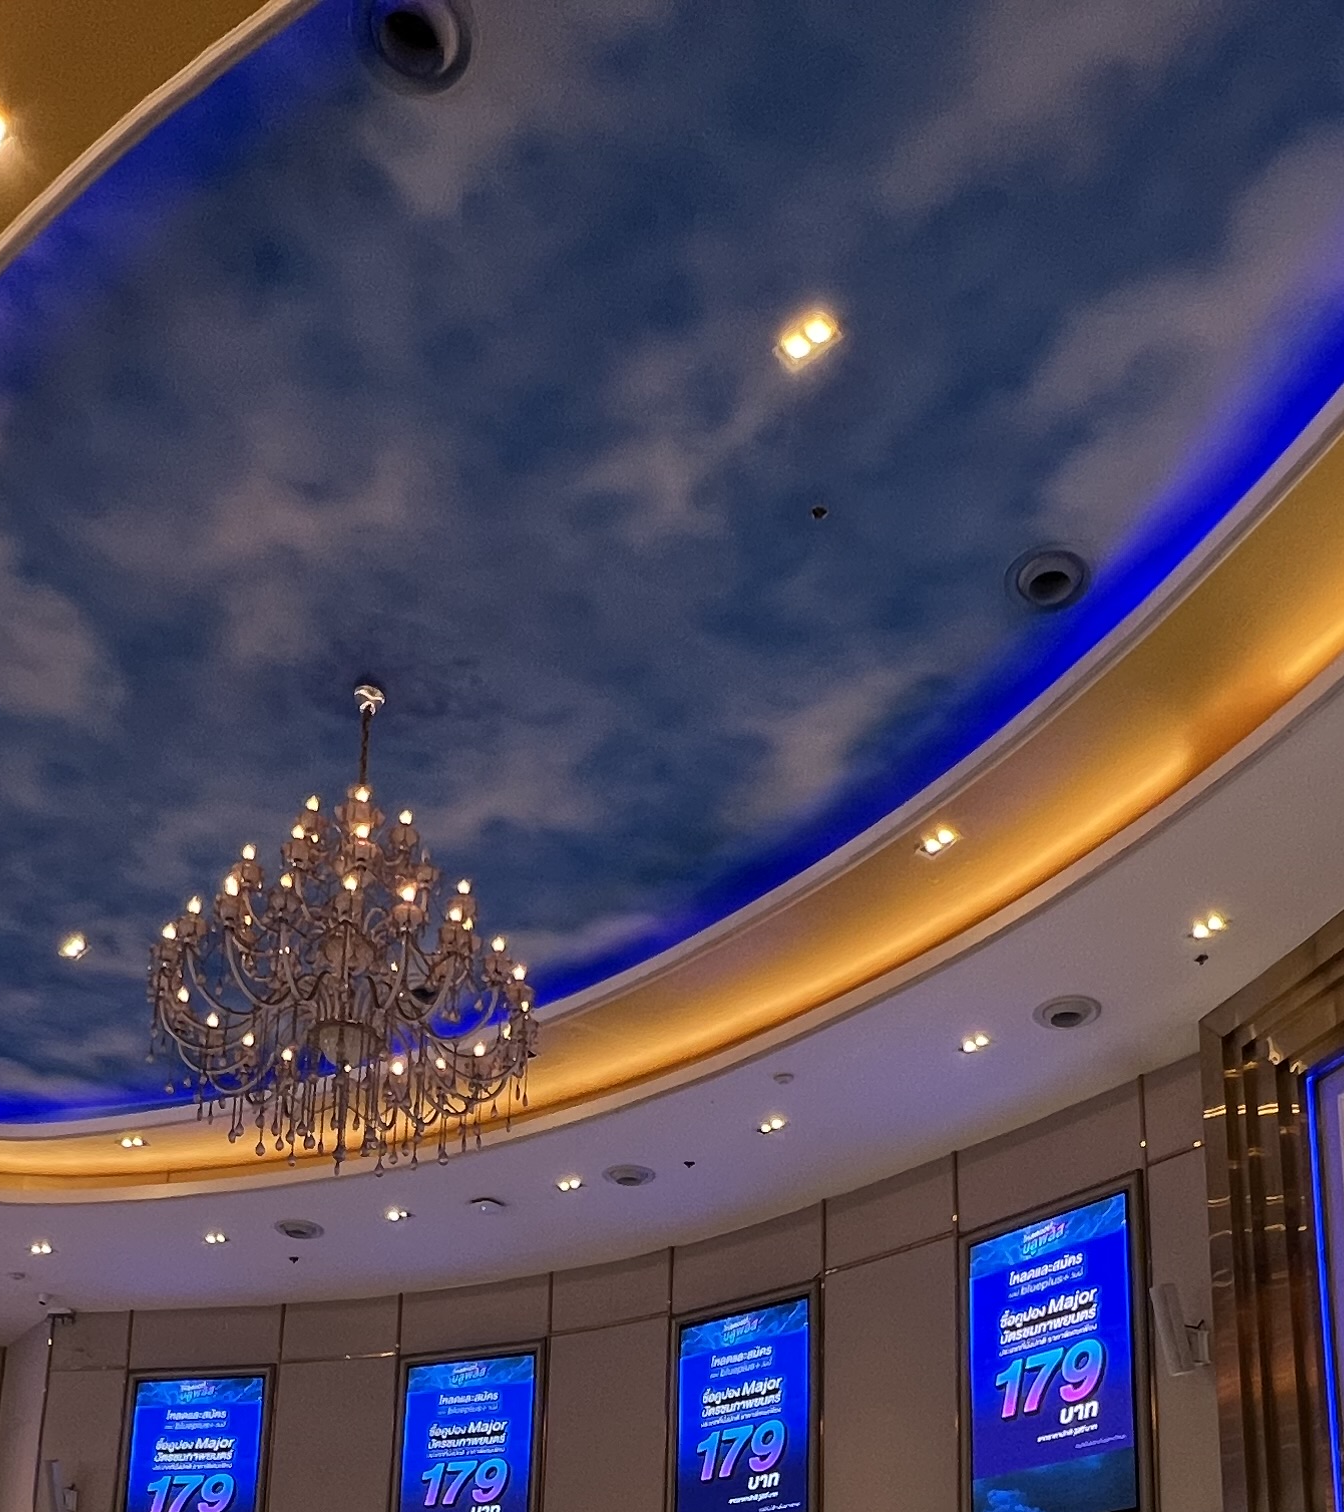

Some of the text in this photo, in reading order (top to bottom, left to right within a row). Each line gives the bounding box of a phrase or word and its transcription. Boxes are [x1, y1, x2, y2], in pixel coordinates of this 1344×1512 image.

[1047, 1288, 1098, 1314] Major
[741, 1375, 783, 1398] Major
[995, 1339, 1105, 1419] 179
[1059, 1400, 1099, 1424] บาท
[467, 1419, 508, 1435] Major
[195, 1436, 235, 1451] Major
[696, 1419, 786, 1481] 179
[421, 1457, 508, 1506] 179
[747, 1472, 780, 1491] บาท
